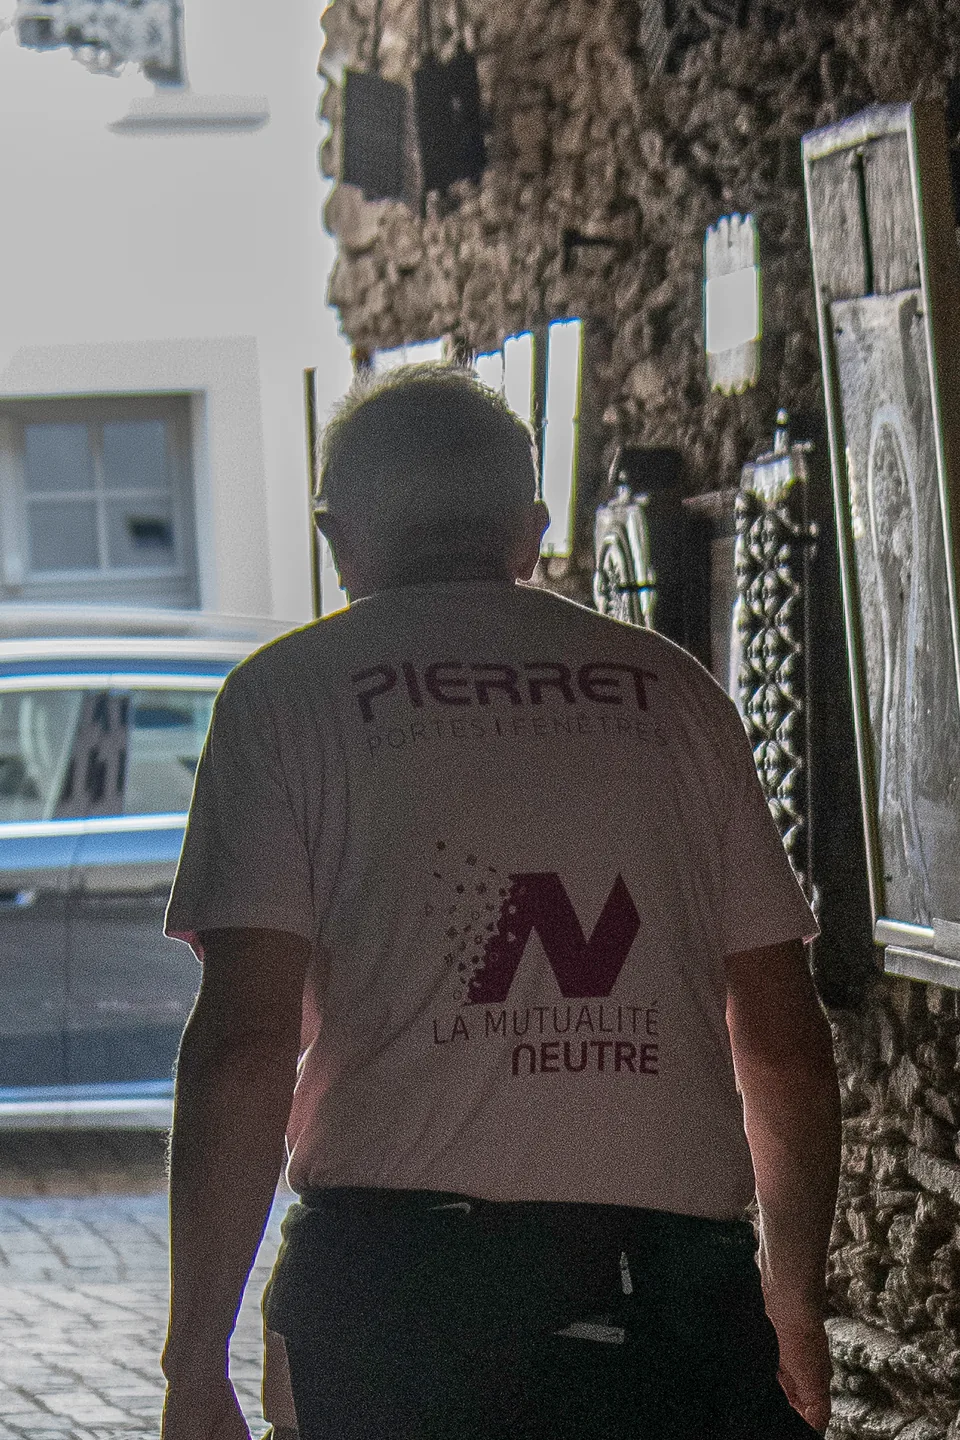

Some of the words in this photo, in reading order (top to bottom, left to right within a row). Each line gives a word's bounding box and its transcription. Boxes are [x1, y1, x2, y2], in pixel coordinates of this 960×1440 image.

[351, 661, 658, 723] PIERRET
[367, 717, 486, 755] PORTES
[433, 1012, 470, 1045] LA
[484, 1001, 660, 1038] MUTUALITÉ
